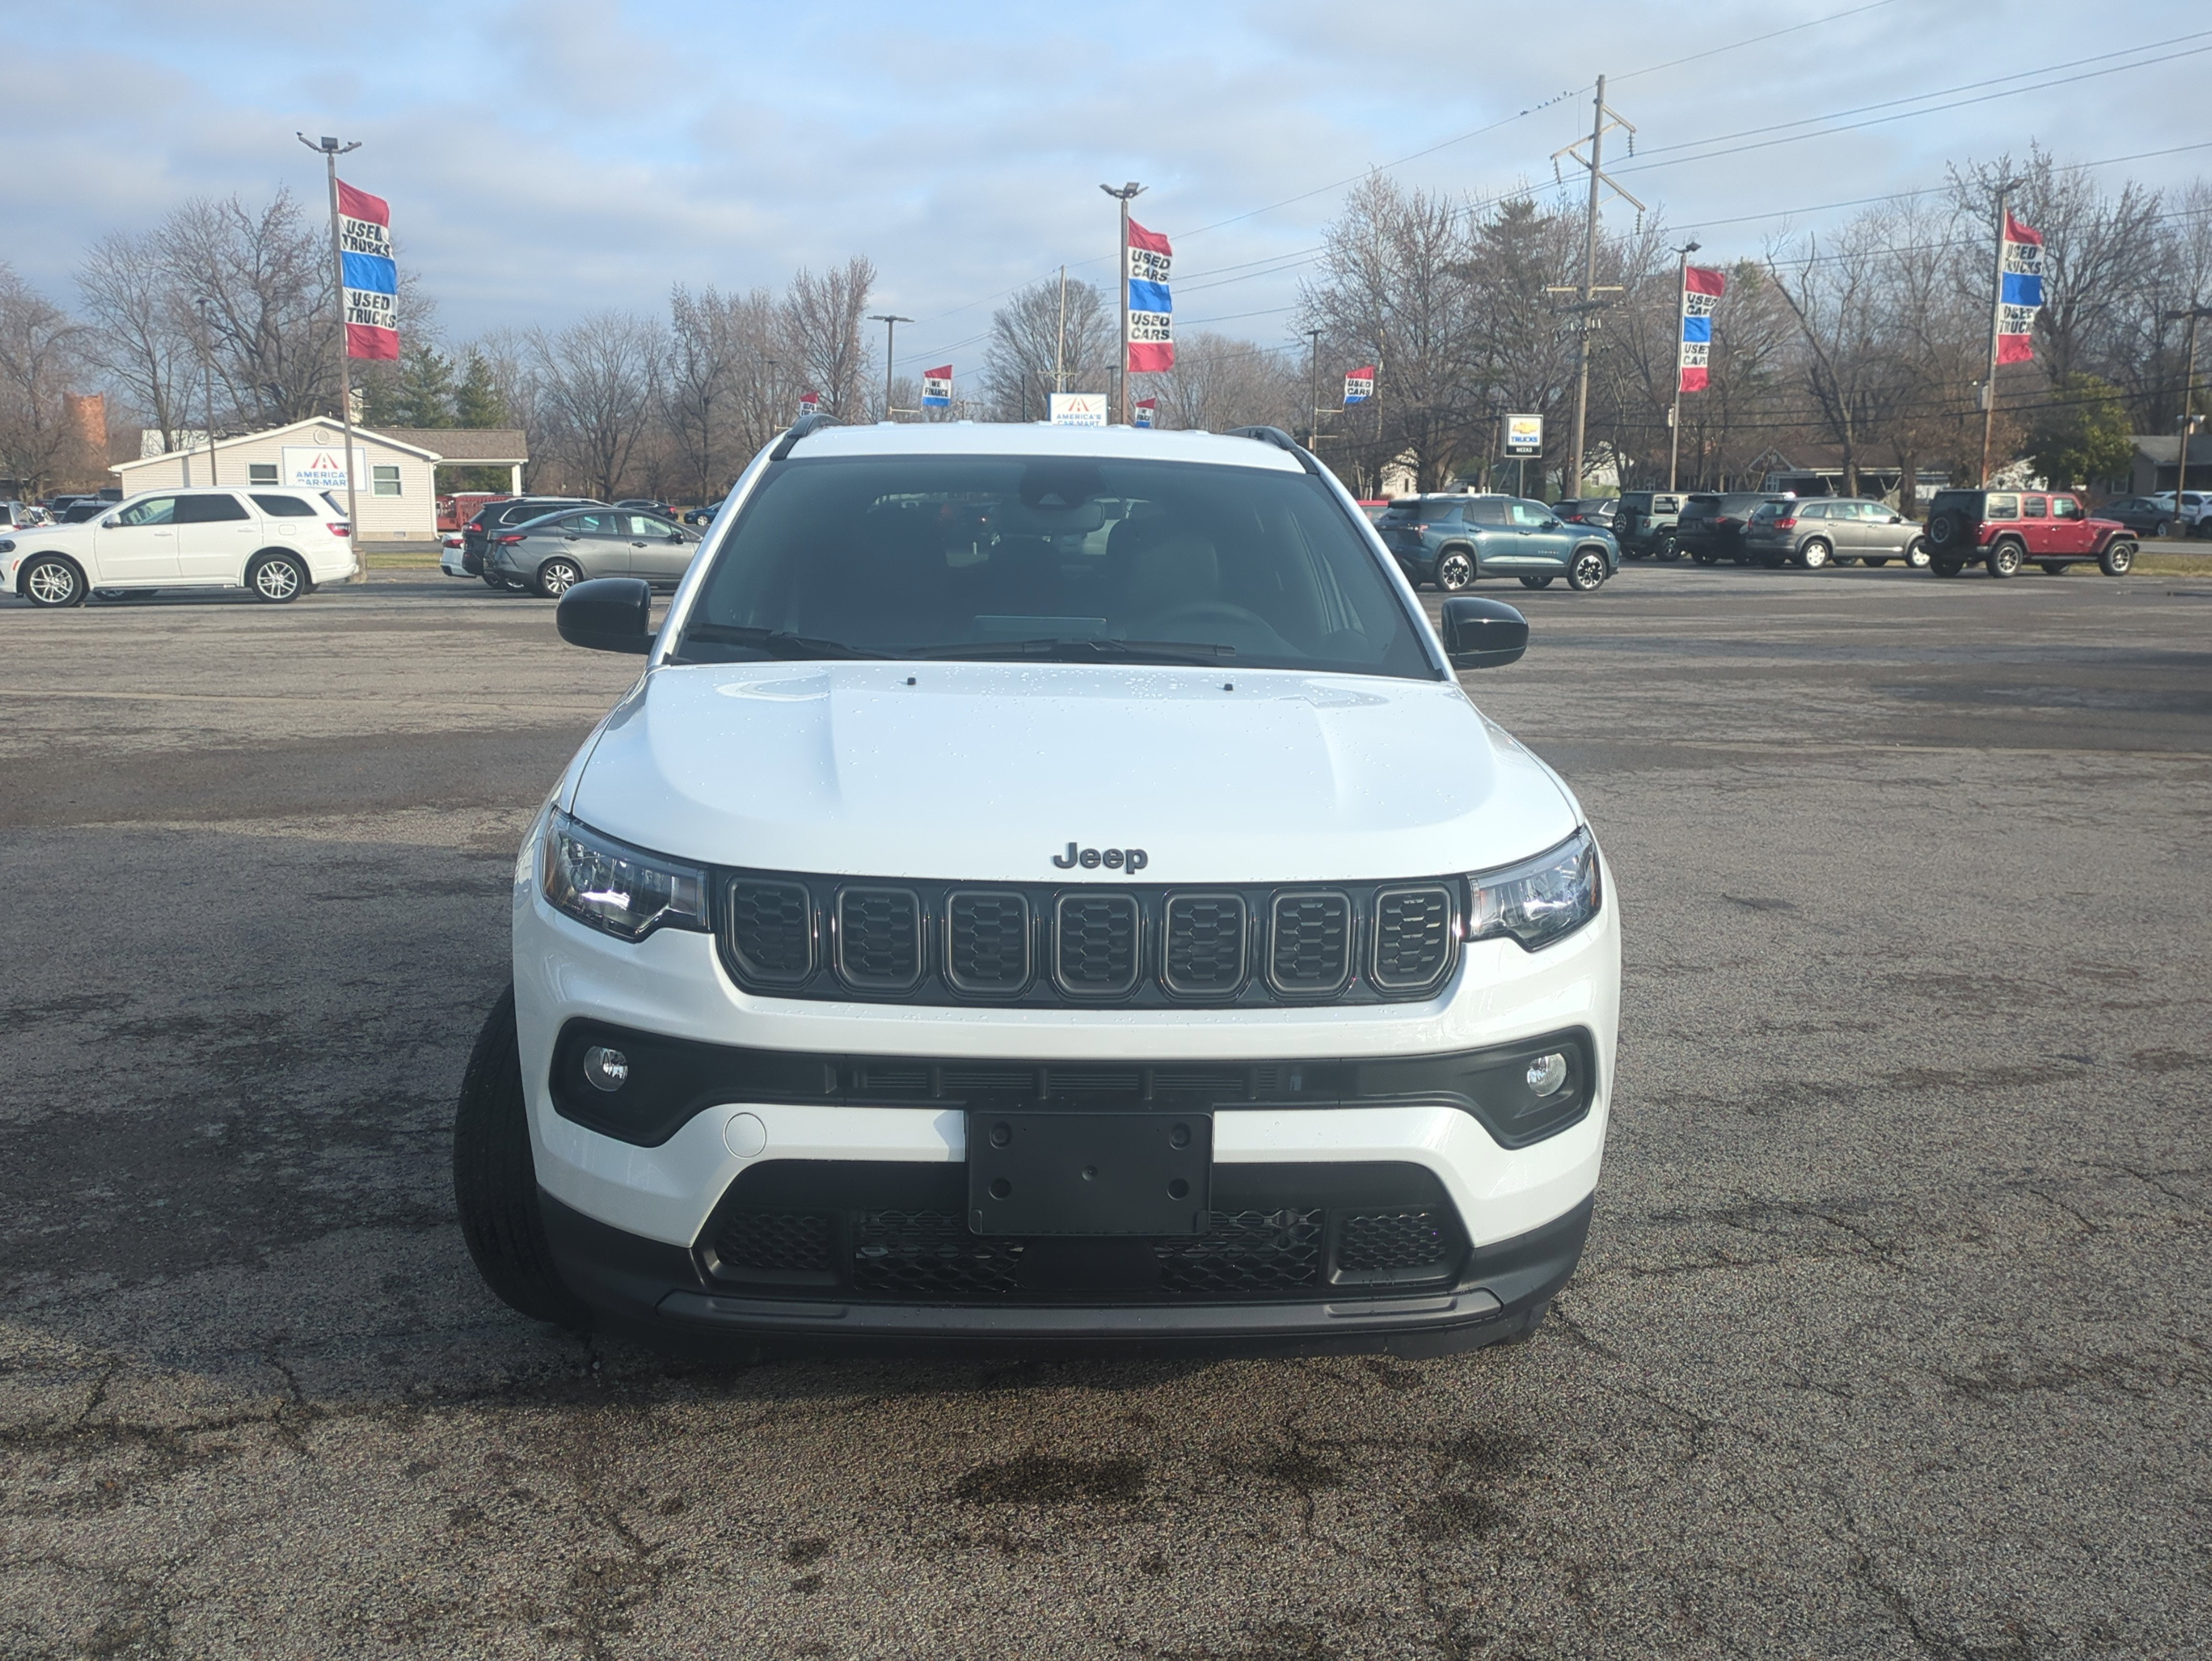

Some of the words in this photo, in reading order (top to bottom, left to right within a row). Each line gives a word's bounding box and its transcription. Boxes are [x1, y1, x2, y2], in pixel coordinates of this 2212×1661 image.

[342, 233, 390, 257] TRUCKS
[2007, 244, 2038, 259] USED
[1132, 250, 1171, 269] USED
[1132, 265, 1170, 282] CARS
[353, 291, 390, 310] USED
[1687, 293, 1717, 306] USED
[347, 307, 396, 328] TRUCKS
[1132, 313, 1170, 326] USED
[1132, 327, 1170, 340] CARS
[1685, 344, 1708, 354] USE
[925, 387, 949, 397] FINANCE
[1053, 842, 1148, 875] Jeep
